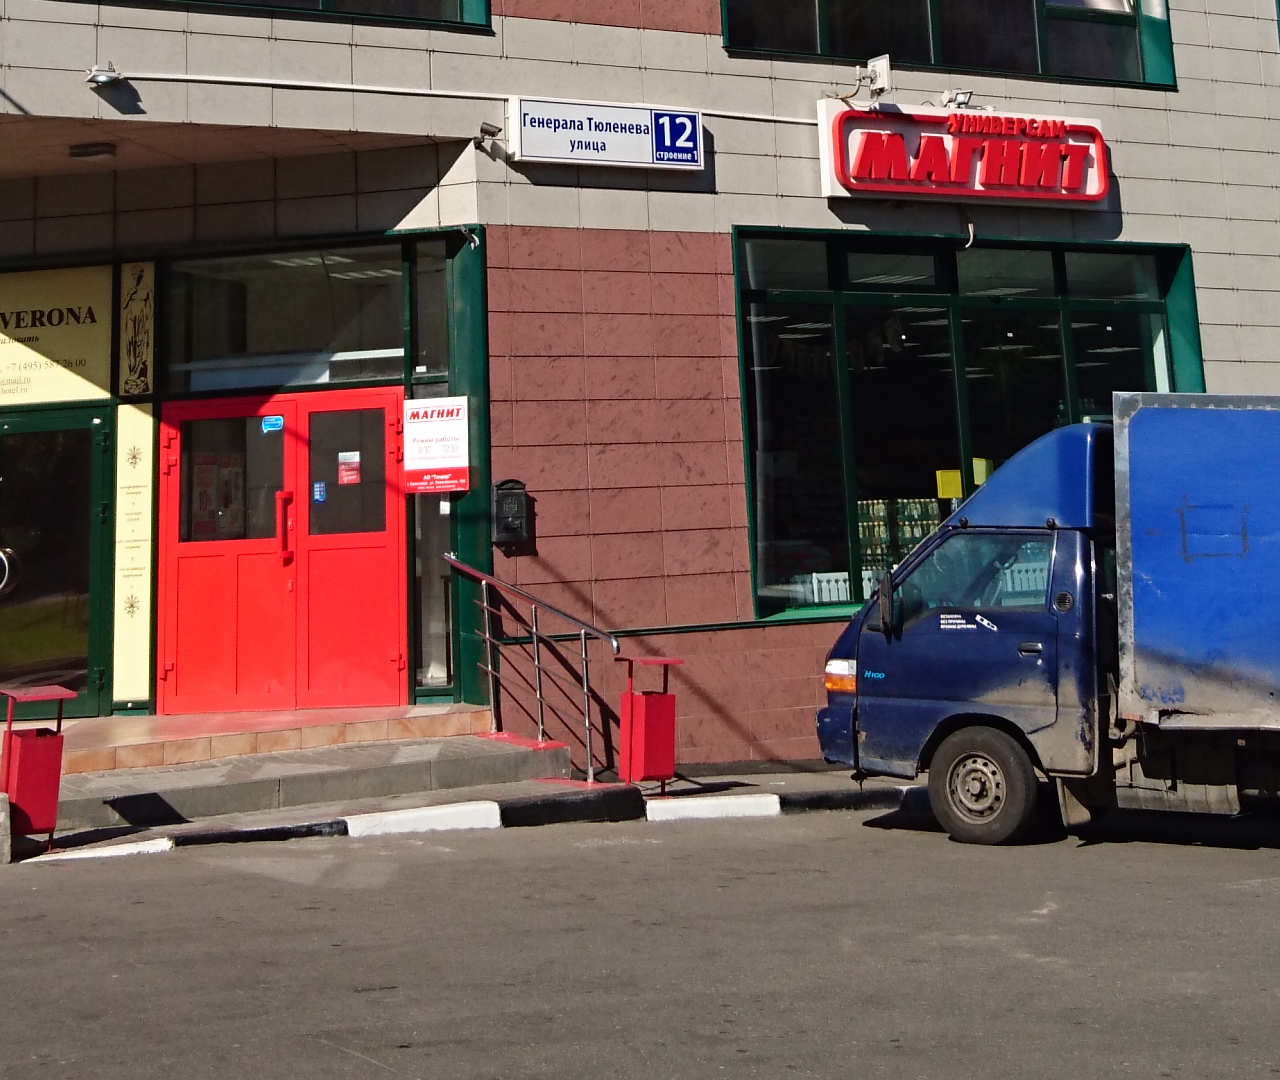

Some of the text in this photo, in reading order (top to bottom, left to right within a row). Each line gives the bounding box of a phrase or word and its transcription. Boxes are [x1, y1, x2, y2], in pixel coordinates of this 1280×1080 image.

[522, 112, 650, 135] Генерала Тюленева
[658, 115, 694, 148] 12
[948, 113, 1067, 138] УНИВЕРСАМ
[569, 139, 607, 154] улица
[656, 150, 698, 161] строение 1
[849, 130, 1091, 190] МАГНИТ
[0, 305, 98, 331] VERONA
[5, 363, 17, 372] +7
[18, 361, 42, 373] (495)
[44, 360, 60, 369] 587
[61, 359, 73, 368] 26
[75, 358, 87, 367] 00
[409, 407, 462, 421] МАГНИТ
